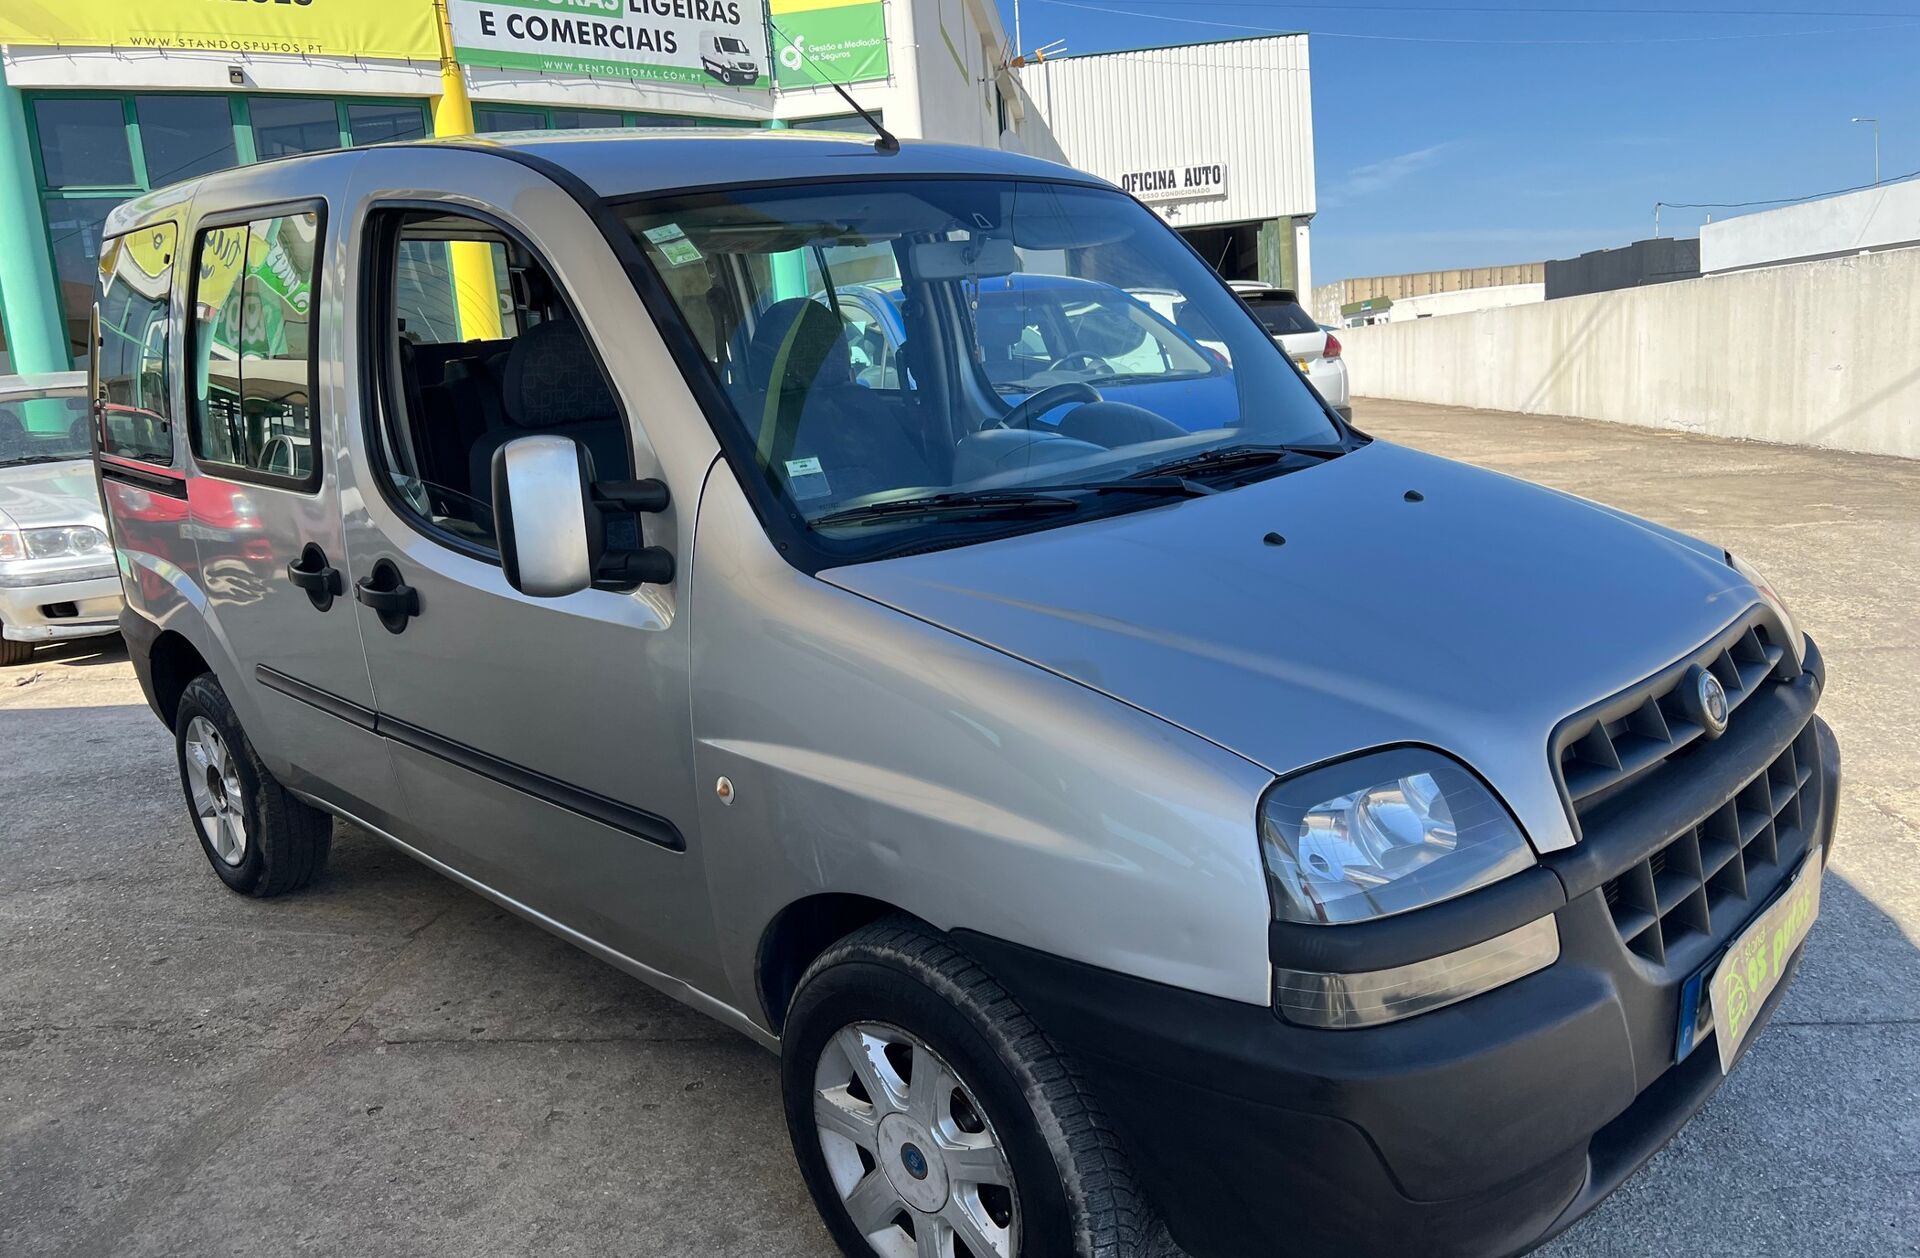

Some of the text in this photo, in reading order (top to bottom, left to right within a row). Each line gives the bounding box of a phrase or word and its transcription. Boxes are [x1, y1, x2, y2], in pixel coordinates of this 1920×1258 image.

[628, 0, 741, 25] LIGEIRAS
[479, 10, 678, 54] E COMERCIAIS
[129, 36, 324, 54] WWW.STANDOSPUTOS.PT
[808, 44, 836, 52] Gestão
[844, 39, 880, 49] Mediação
[821, 51, 850, 61] Seguros
[543, 60, 701, 82] WWW.RENTOLITORAL.COM.PT
[1121, 165, 1221, 193] OFICINA AUTO
[1137, 187, 1211, 200] CESSO CONDICIONADO
